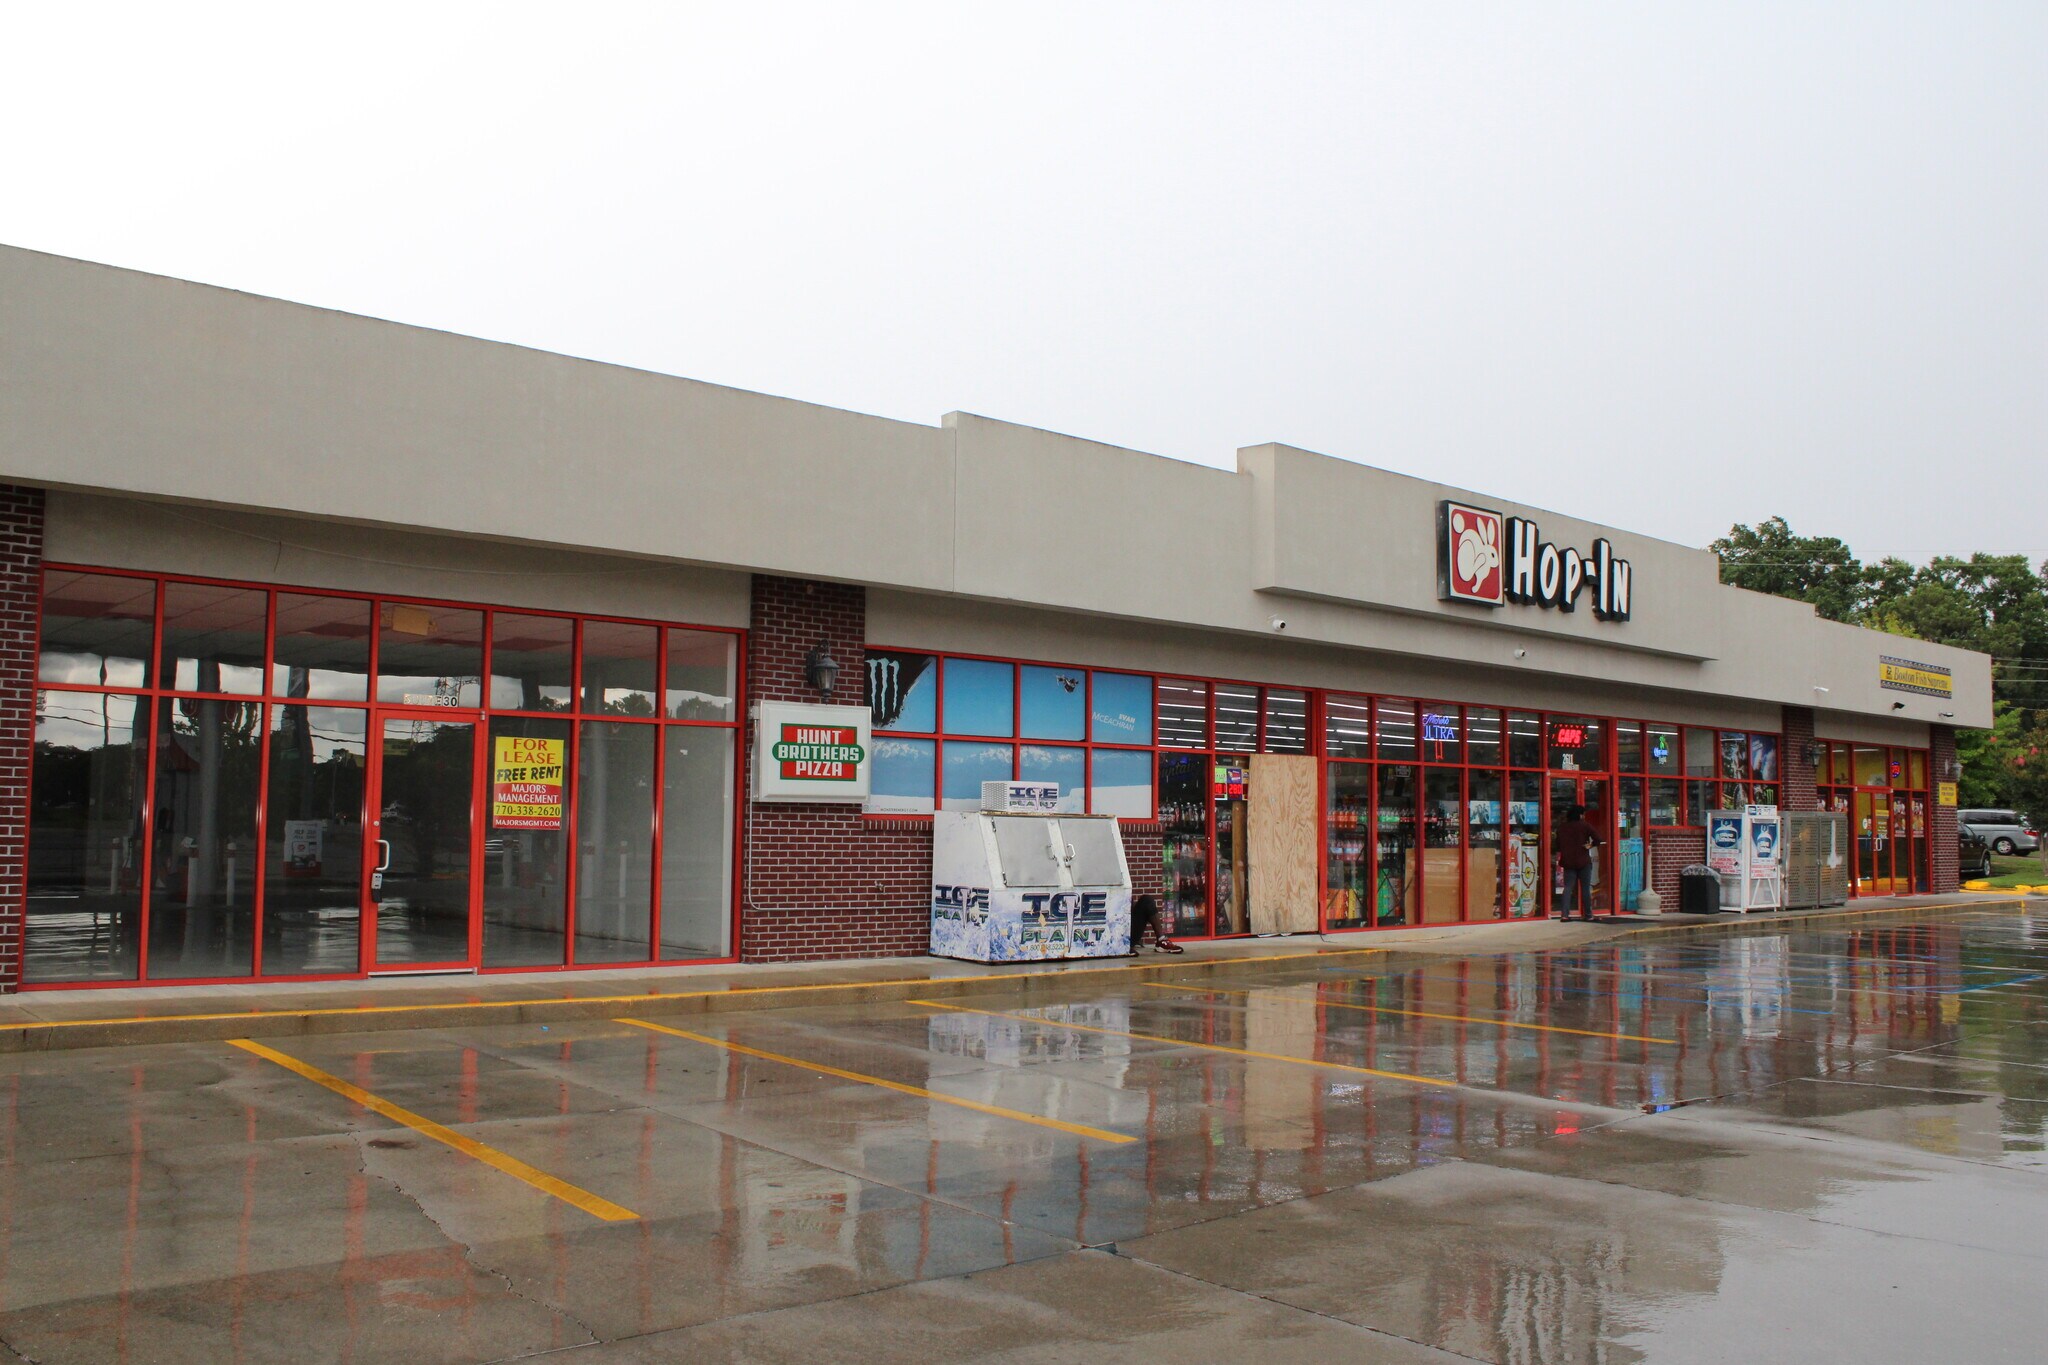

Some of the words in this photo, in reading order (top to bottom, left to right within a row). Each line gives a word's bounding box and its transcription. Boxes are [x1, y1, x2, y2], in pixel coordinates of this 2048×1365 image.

[443, 696, 457, 707] 30
[797, 728, 842, 745] HUNT
[513, 738, 548, 751] FOR
[503, 751, 556, 765] LEASE
[778, 744, 860, 761] BROTHERS
[496, 767, 527, 782] FREE
[530, 766, 561, 780] RENT
[795, 760, 843, 777] PIZZA
[511, 783, 547, 794] MAJORS
[1009, 786, 1058, 798] ICE
[498, 793, 559, 804] MANAGEMENT
[495, 805, 561, 816] 770-338-2620
[495, 819, 561, 827] MAJORSMGMT.COM
[935, 884, 990, 907] ICE
[1021, 892, 1107, 919] ICE
[1020, 928, 1106, 944] PLANT
